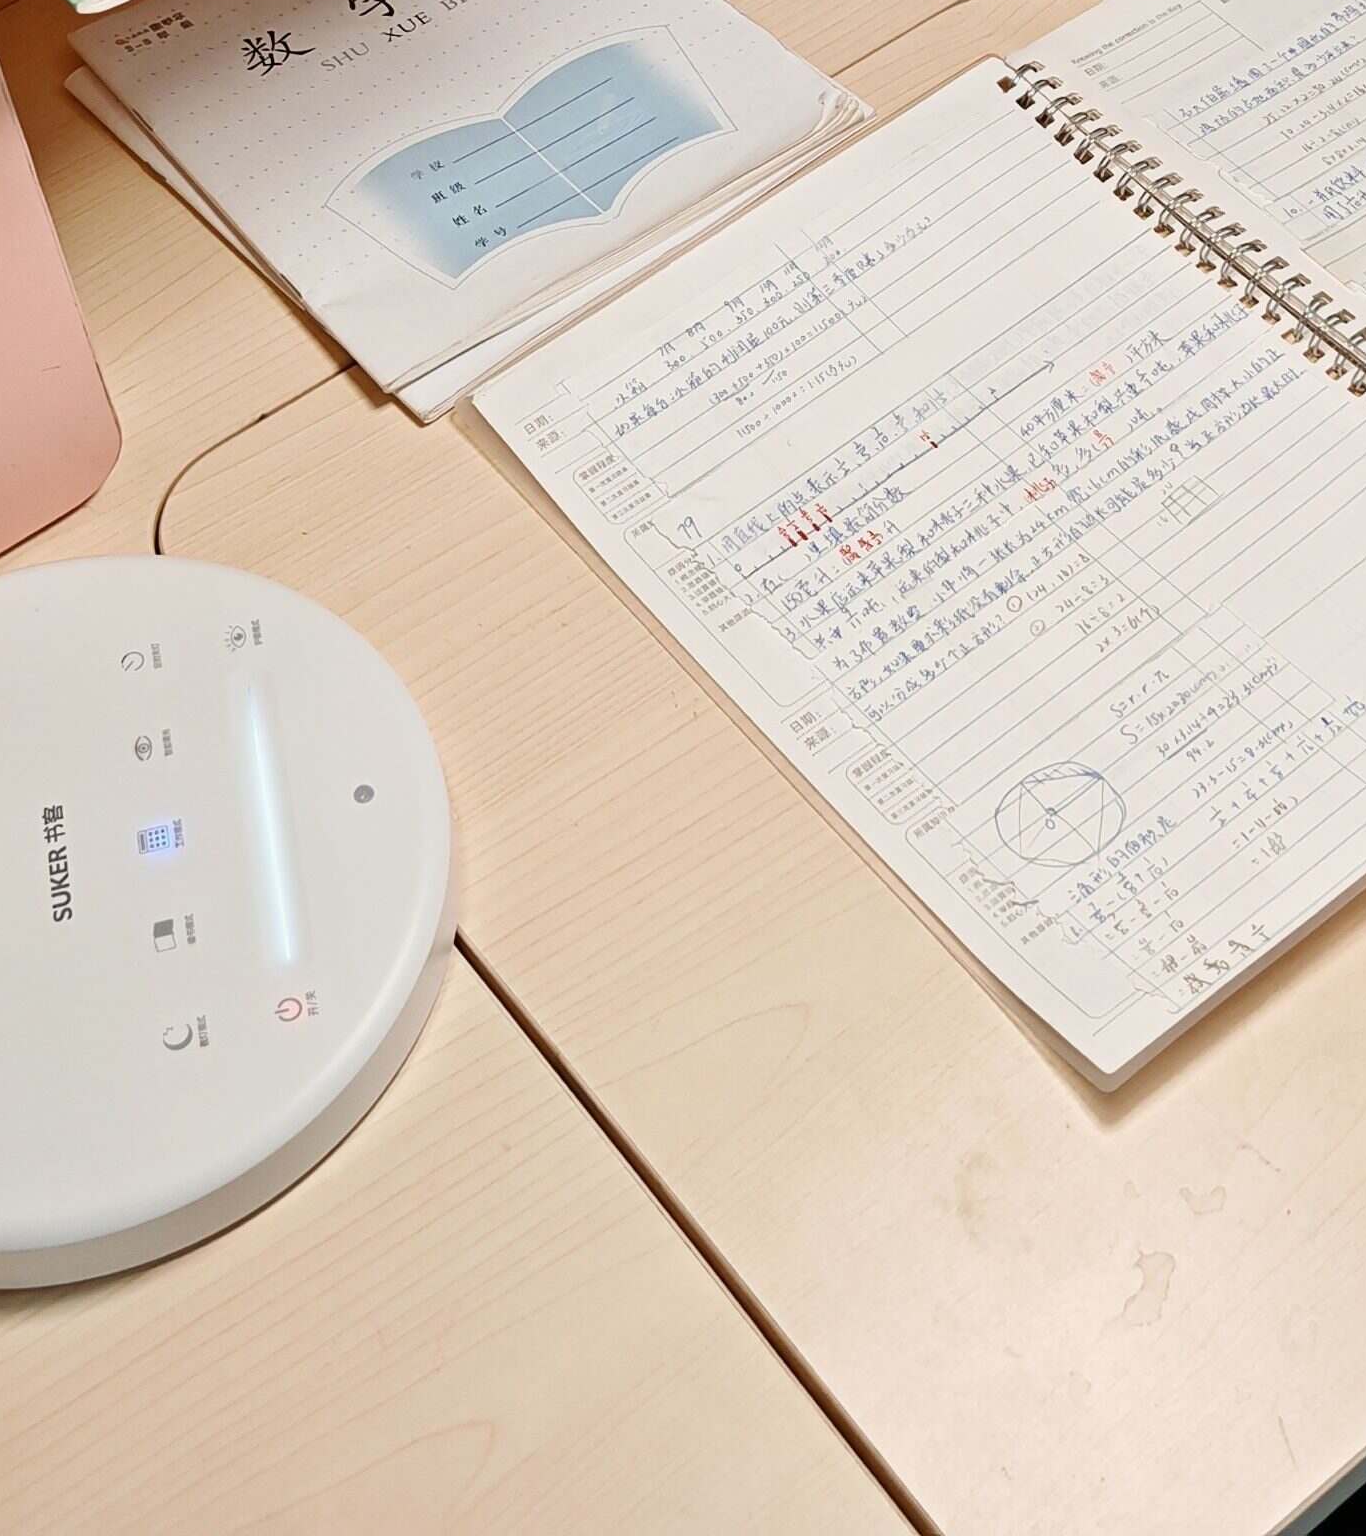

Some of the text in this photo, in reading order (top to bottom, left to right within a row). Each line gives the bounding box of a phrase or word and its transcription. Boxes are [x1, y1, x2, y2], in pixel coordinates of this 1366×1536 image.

[319, 41, 371, 75] SHU
[381, 9, 434, 46] XUE
[430, 179, 468, 205] 班级
[450, 203, 489, 229] 姓名
[472, 225, 509, 250] 学号
[786, 705, 823, 735] 日期：
[800, 721, 839, 752] 来源：
[41, 803, 73, 924] SUKER 书客
